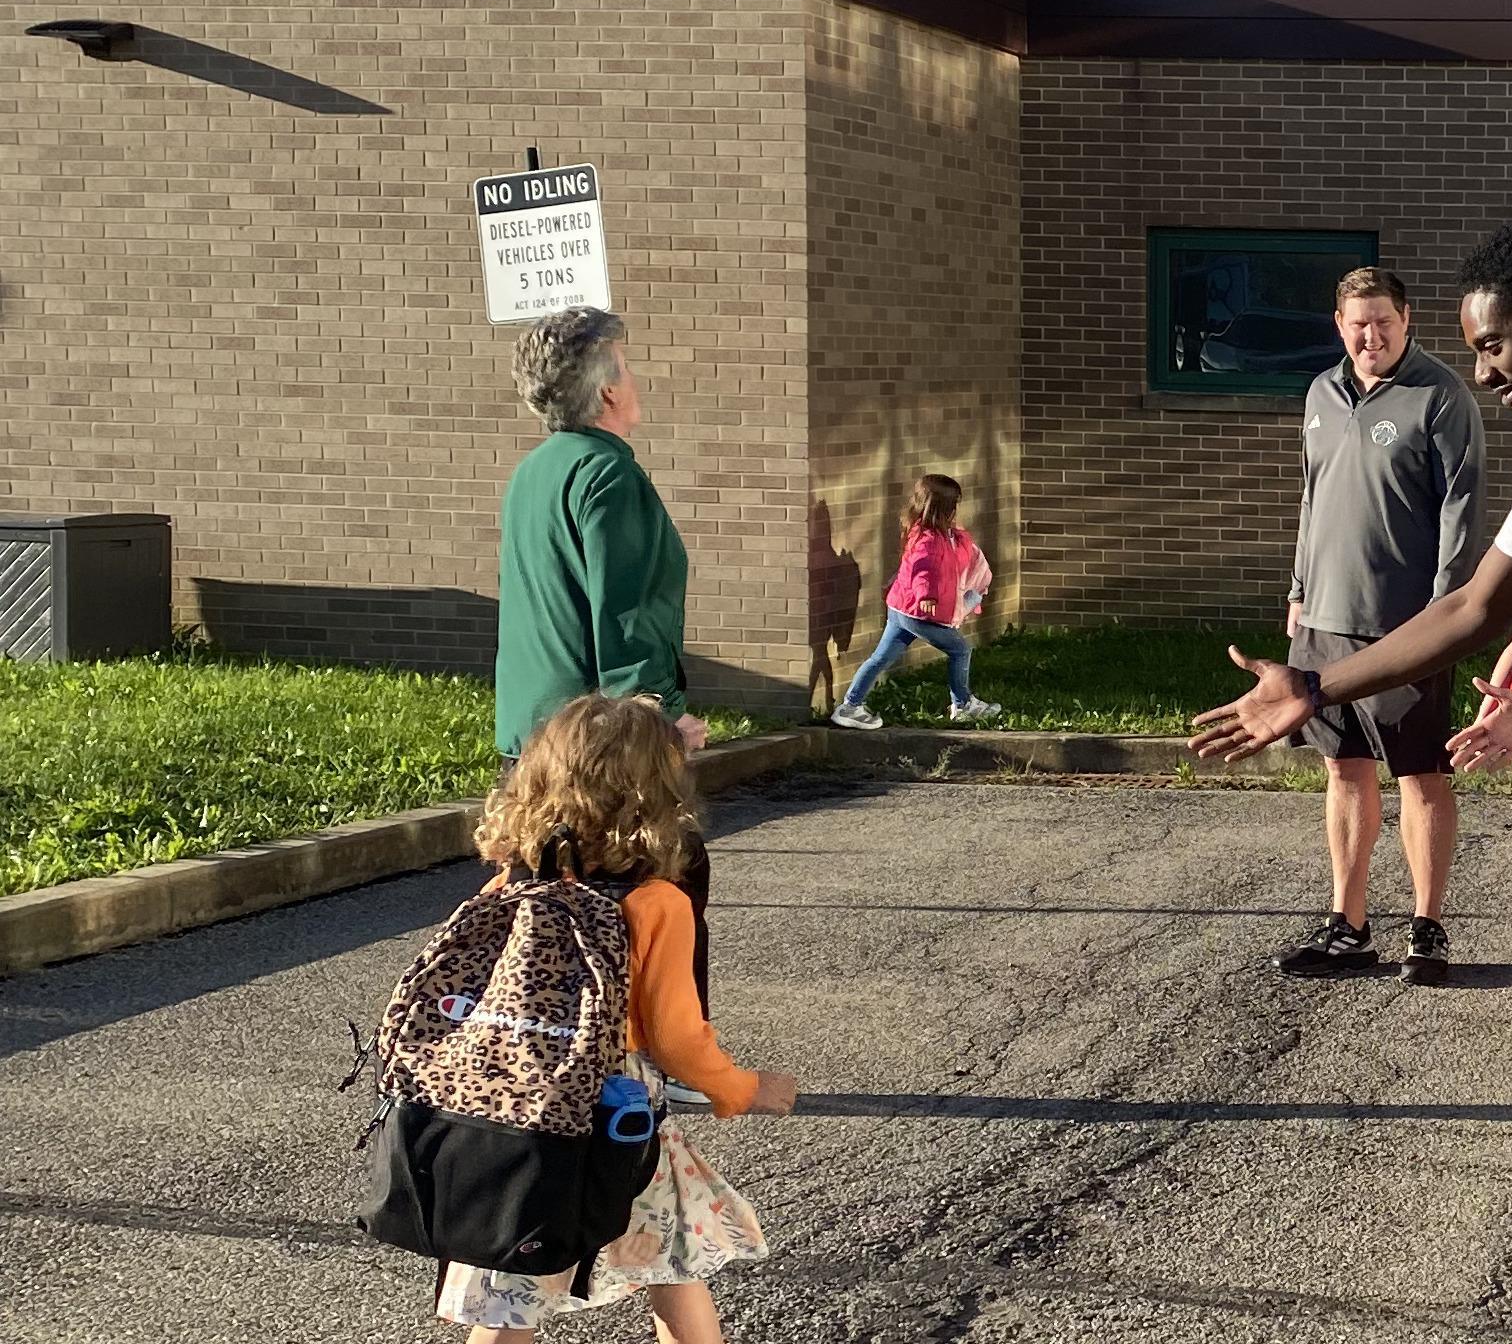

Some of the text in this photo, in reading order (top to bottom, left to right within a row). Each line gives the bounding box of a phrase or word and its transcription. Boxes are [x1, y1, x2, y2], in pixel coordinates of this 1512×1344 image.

[484, 173, 589, 206] NO IDLING
[490, 212, 591, 240] DIESEL-POWERED
[497, 239, 590, 266] VEHICLES OVER
[520, 268, 574, 289] 5 TONS
